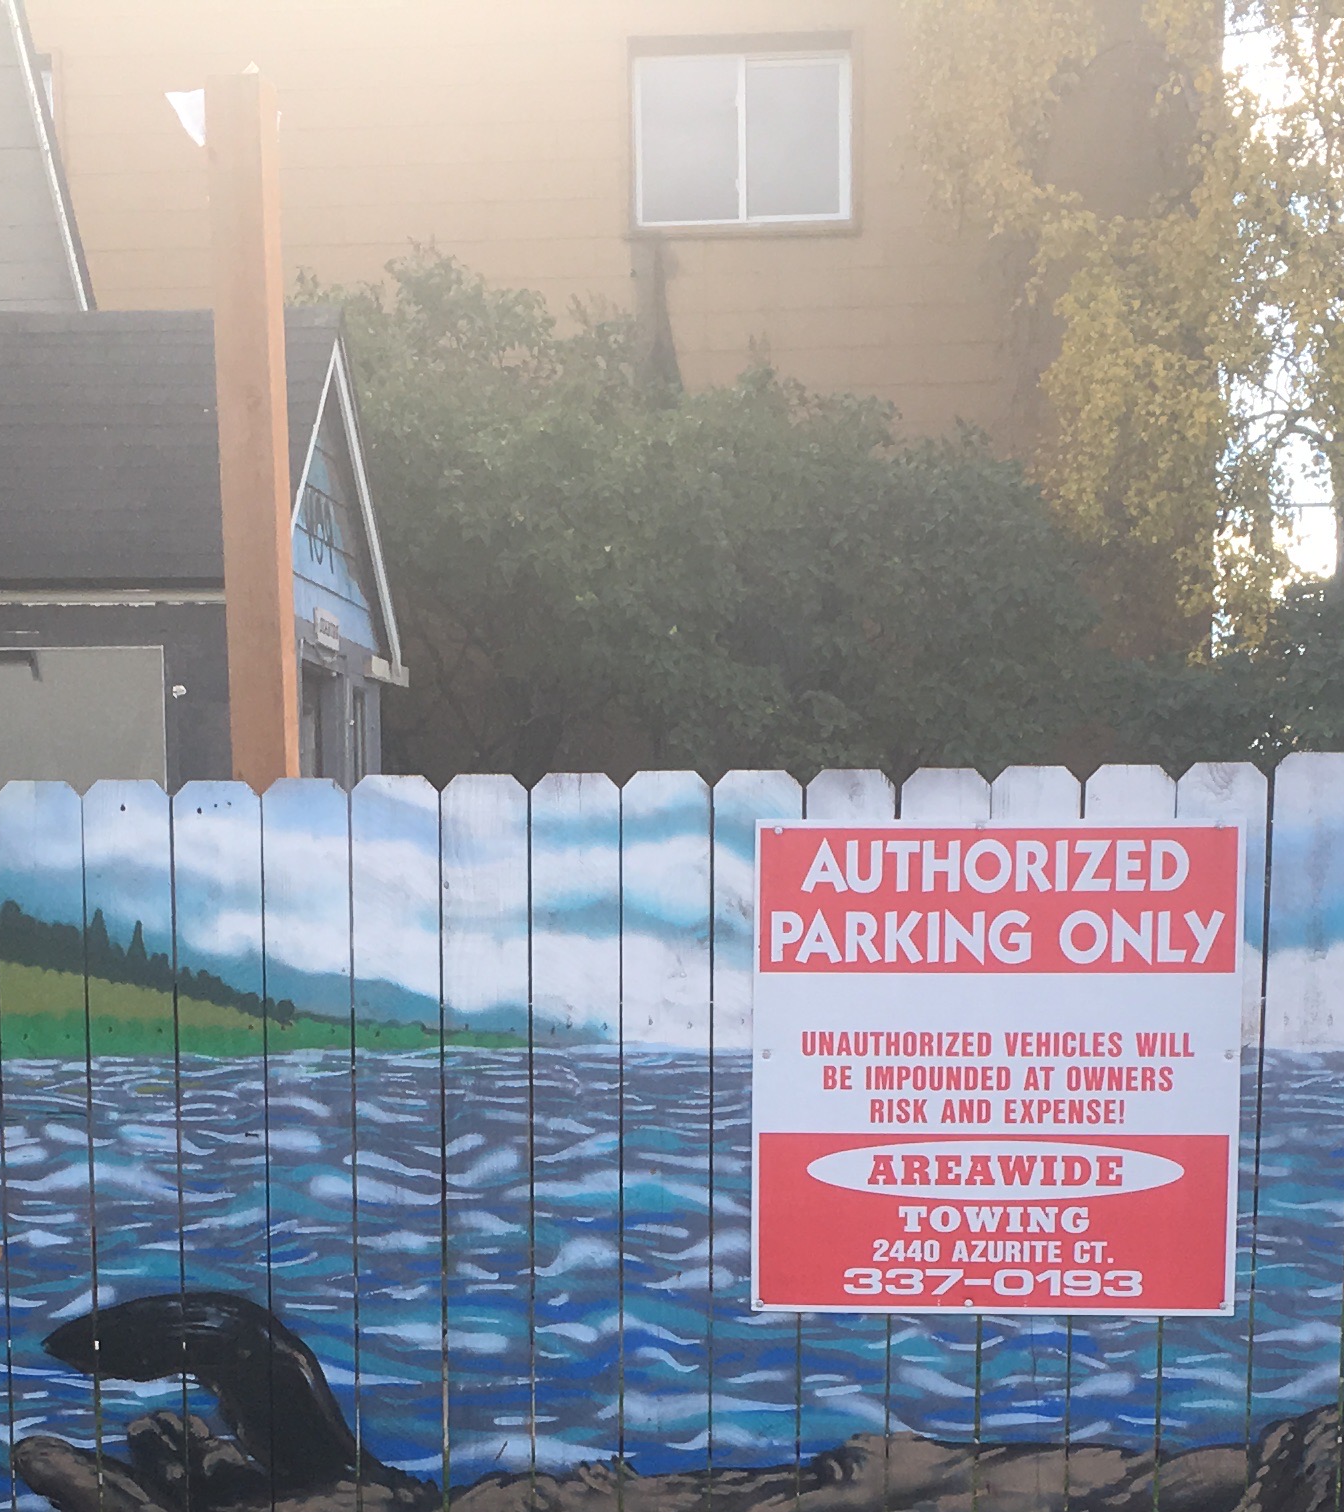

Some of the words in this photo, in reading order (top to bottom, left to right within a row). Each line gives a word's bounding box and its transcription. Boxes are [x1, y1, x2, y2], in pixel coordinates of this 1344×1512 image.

[800, 837, 1191, 895] AUTHORIZED
[769, 907, 1033, 966] PARKING
[1058, 907, 1226, 966] ONLY
[801, 1031, 993, 1058] UNAUTHORIZED
[1004, 1031, 1123, 1058] VEHICLES
[1135, 1032, 1195, 1058] WILL
[822, 1065, 852, 1091] BE
[865, 1065, 1012, 1092] IMPOUNDED
[1023, 1065, 1055, 1091] AT
[1066, 1065, 1175, 1092] OWNERS
[869, 1098, 928, 1124] RISK
[940, 1098, 992, 1124] AND
[1003, 1098, 1126, 1125] EXPENSE!
[866, 1154, 1124, 1187] AREAWIDE
[897, 1205, 1091, 1234] TOWING
[871, 1238, 941, 1263] 2440
[951, 1240, 1063, 1264] AZURITE
[1073, 1241, 1115, 1265] CT.
[842, 1267, 1144, 1298] 337-0193
